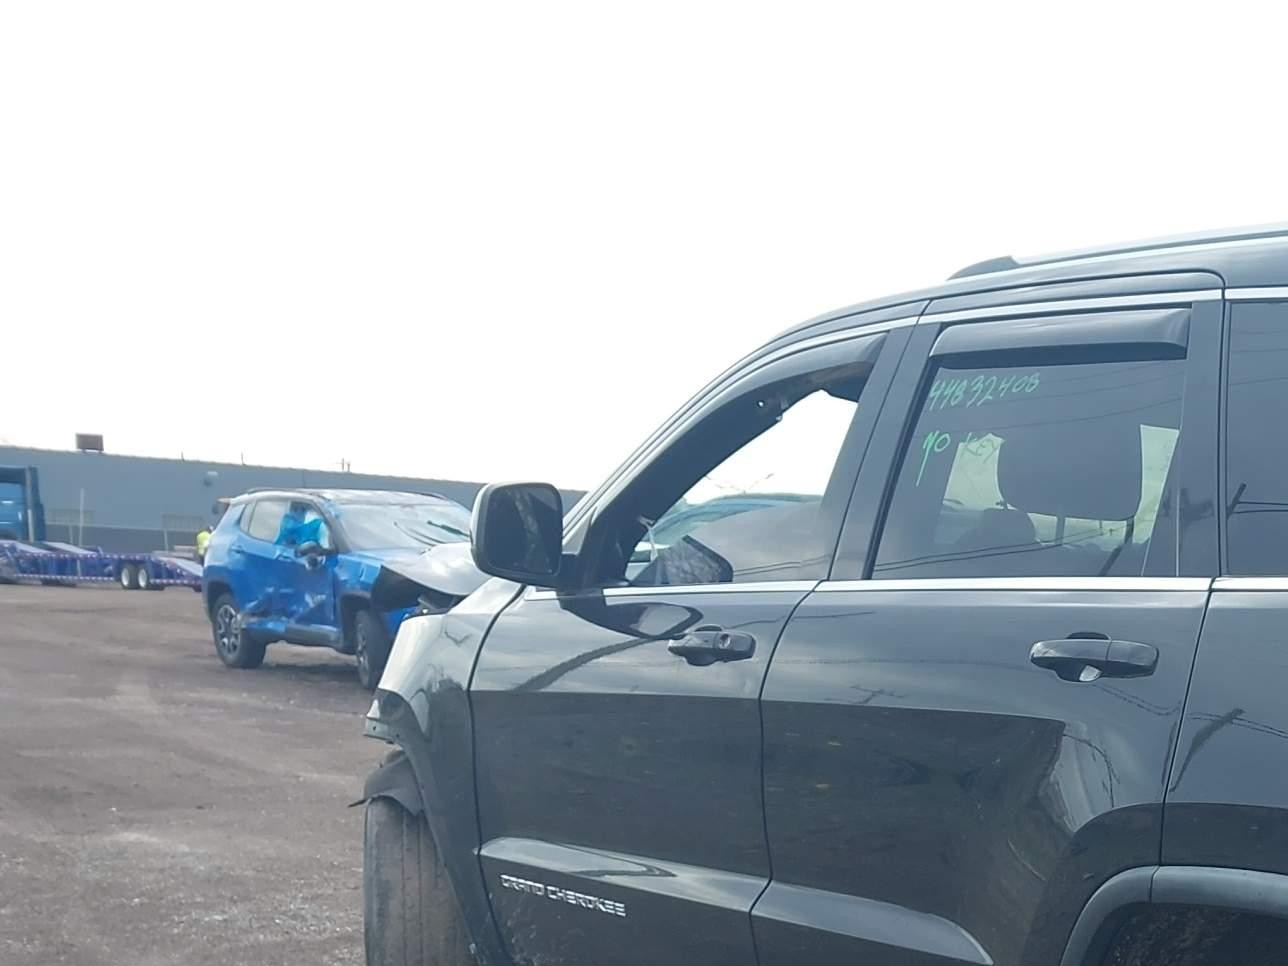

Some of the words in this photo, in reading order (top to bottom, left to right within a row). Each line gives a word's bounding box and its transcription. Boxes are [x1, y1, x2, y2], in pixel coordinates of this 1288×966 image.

[929, 373, 1039, 411] 44832408
[921, 430, 951, 454] NO
[547, 886, 626, 917] CHEROKEE
